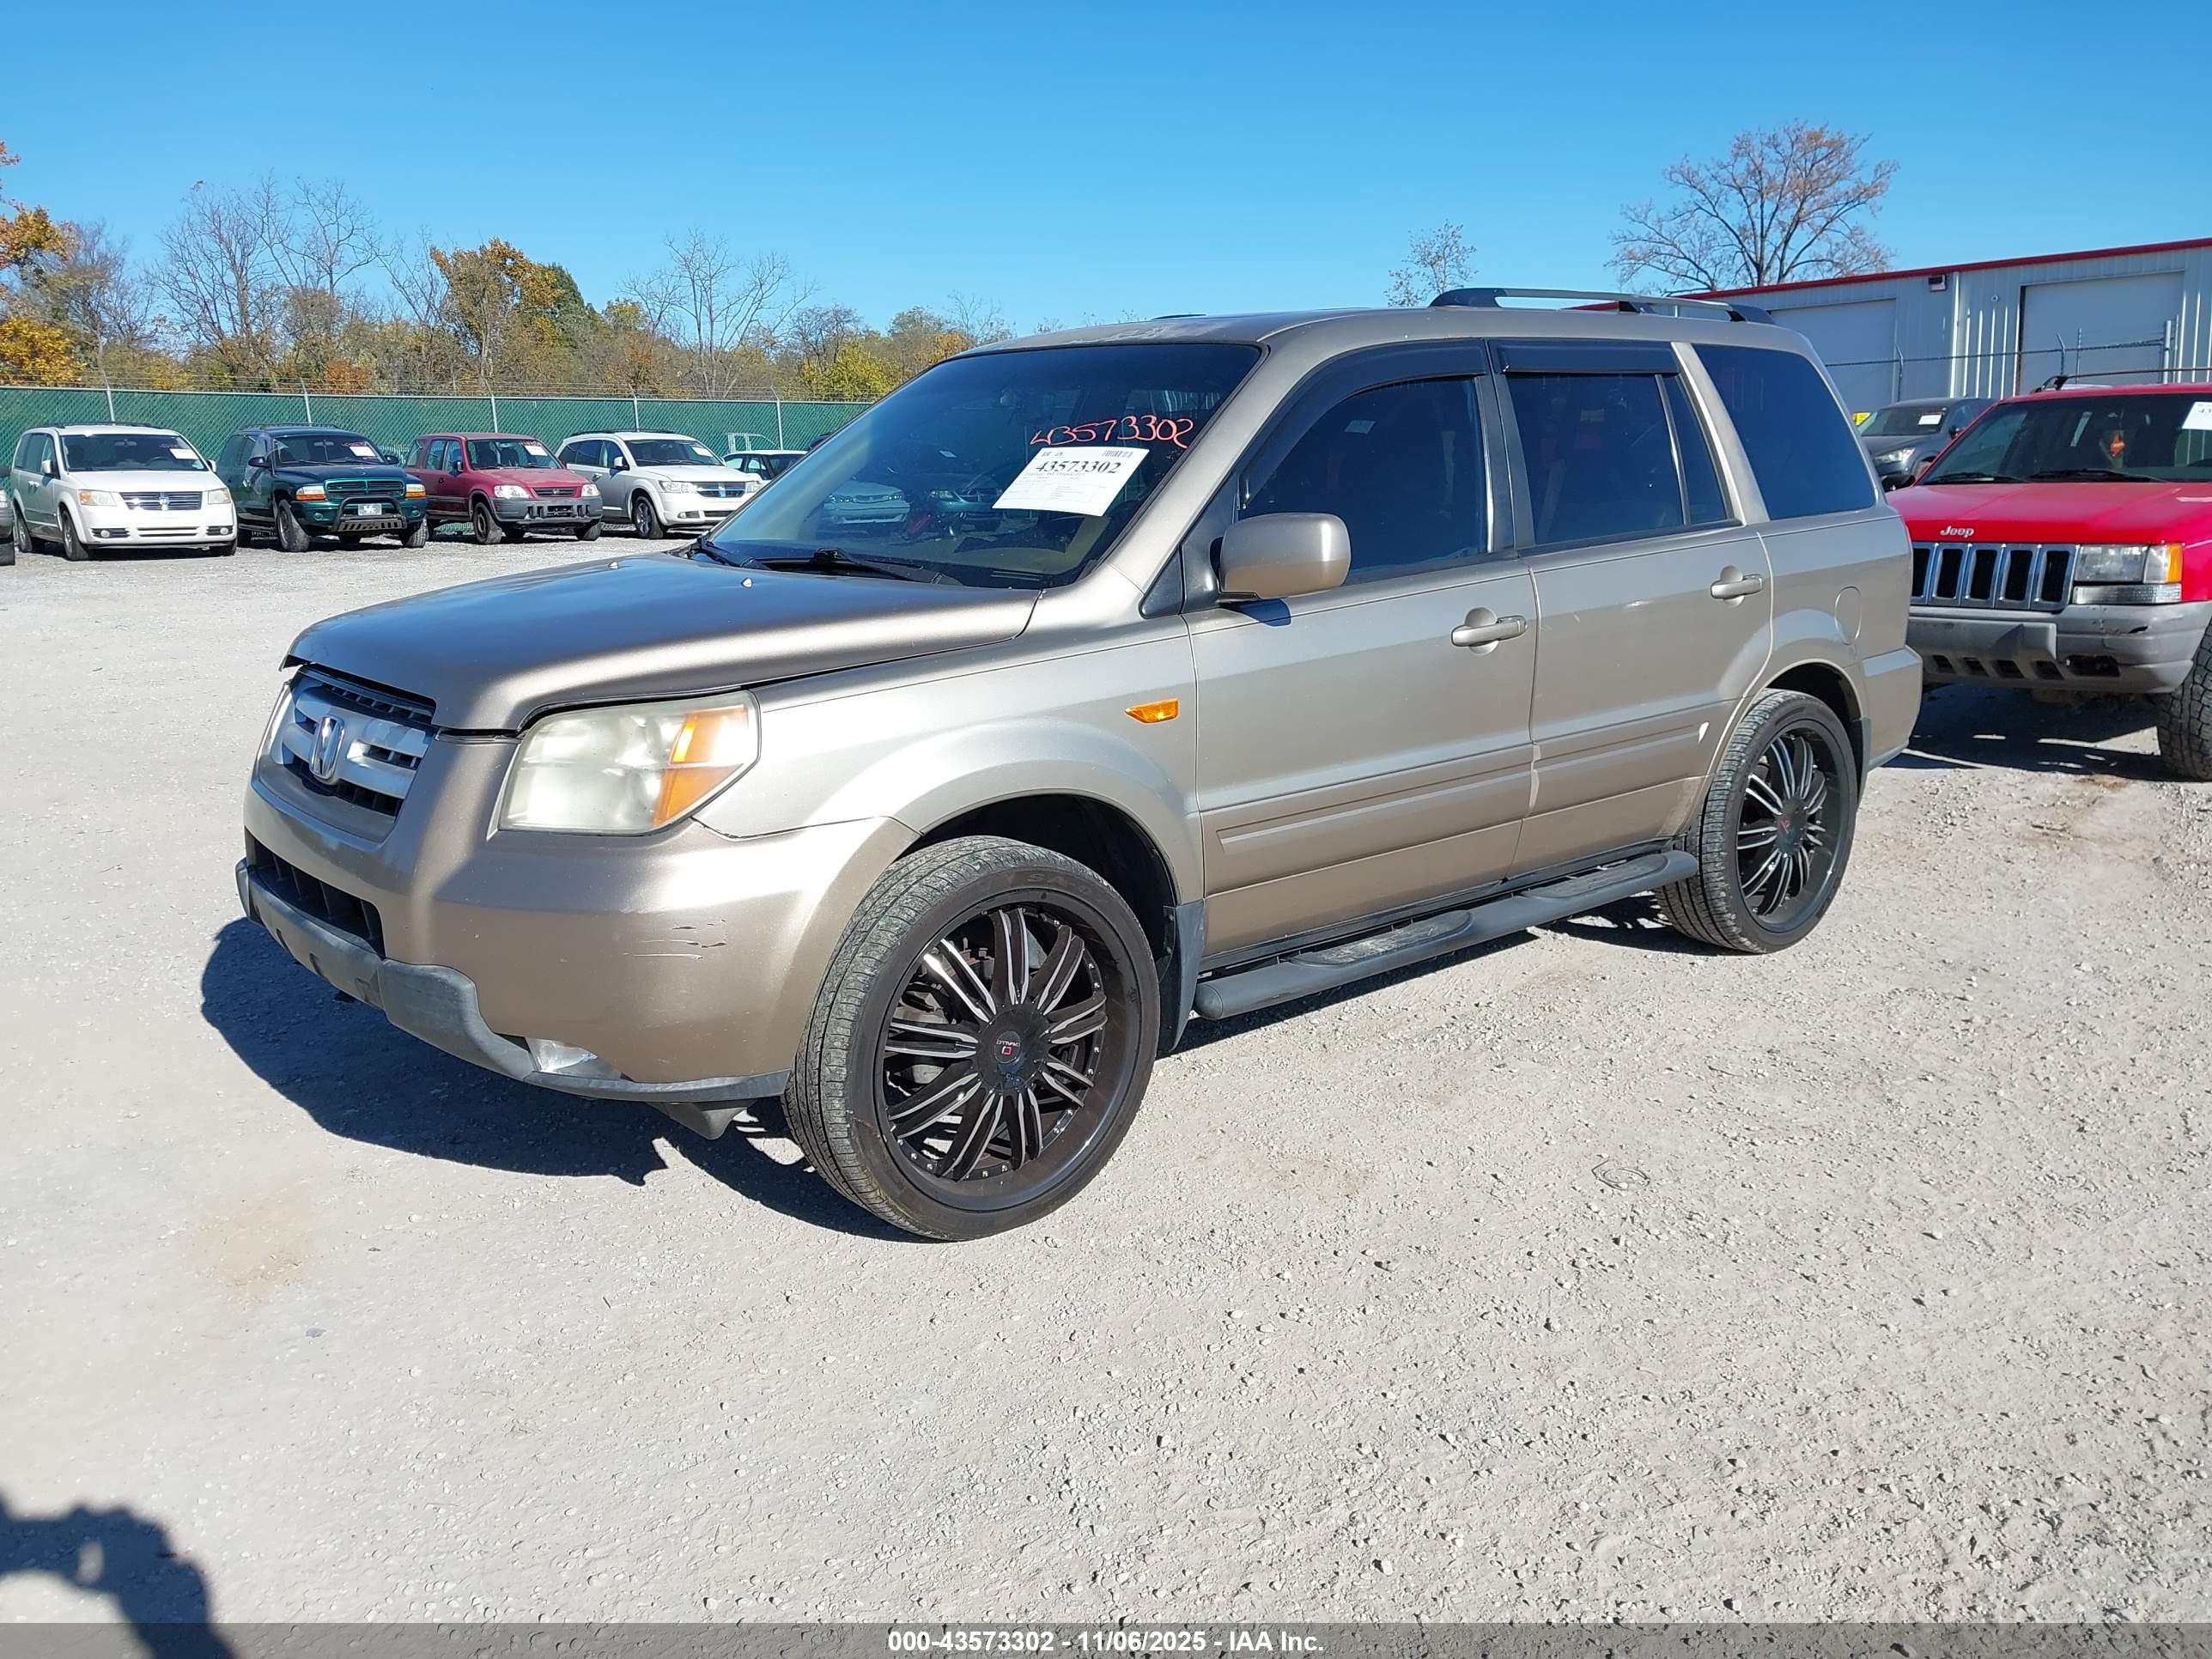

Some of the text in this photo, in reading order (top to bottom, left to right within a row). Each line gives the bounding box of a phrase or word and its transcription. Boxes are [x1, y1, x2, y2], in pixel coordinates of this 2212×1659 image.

[1030, 415, 1194, 449] 43573302
[1036, 460, 1121, 474] 43573302
[1940, 526, 1974, 538] Jeep
